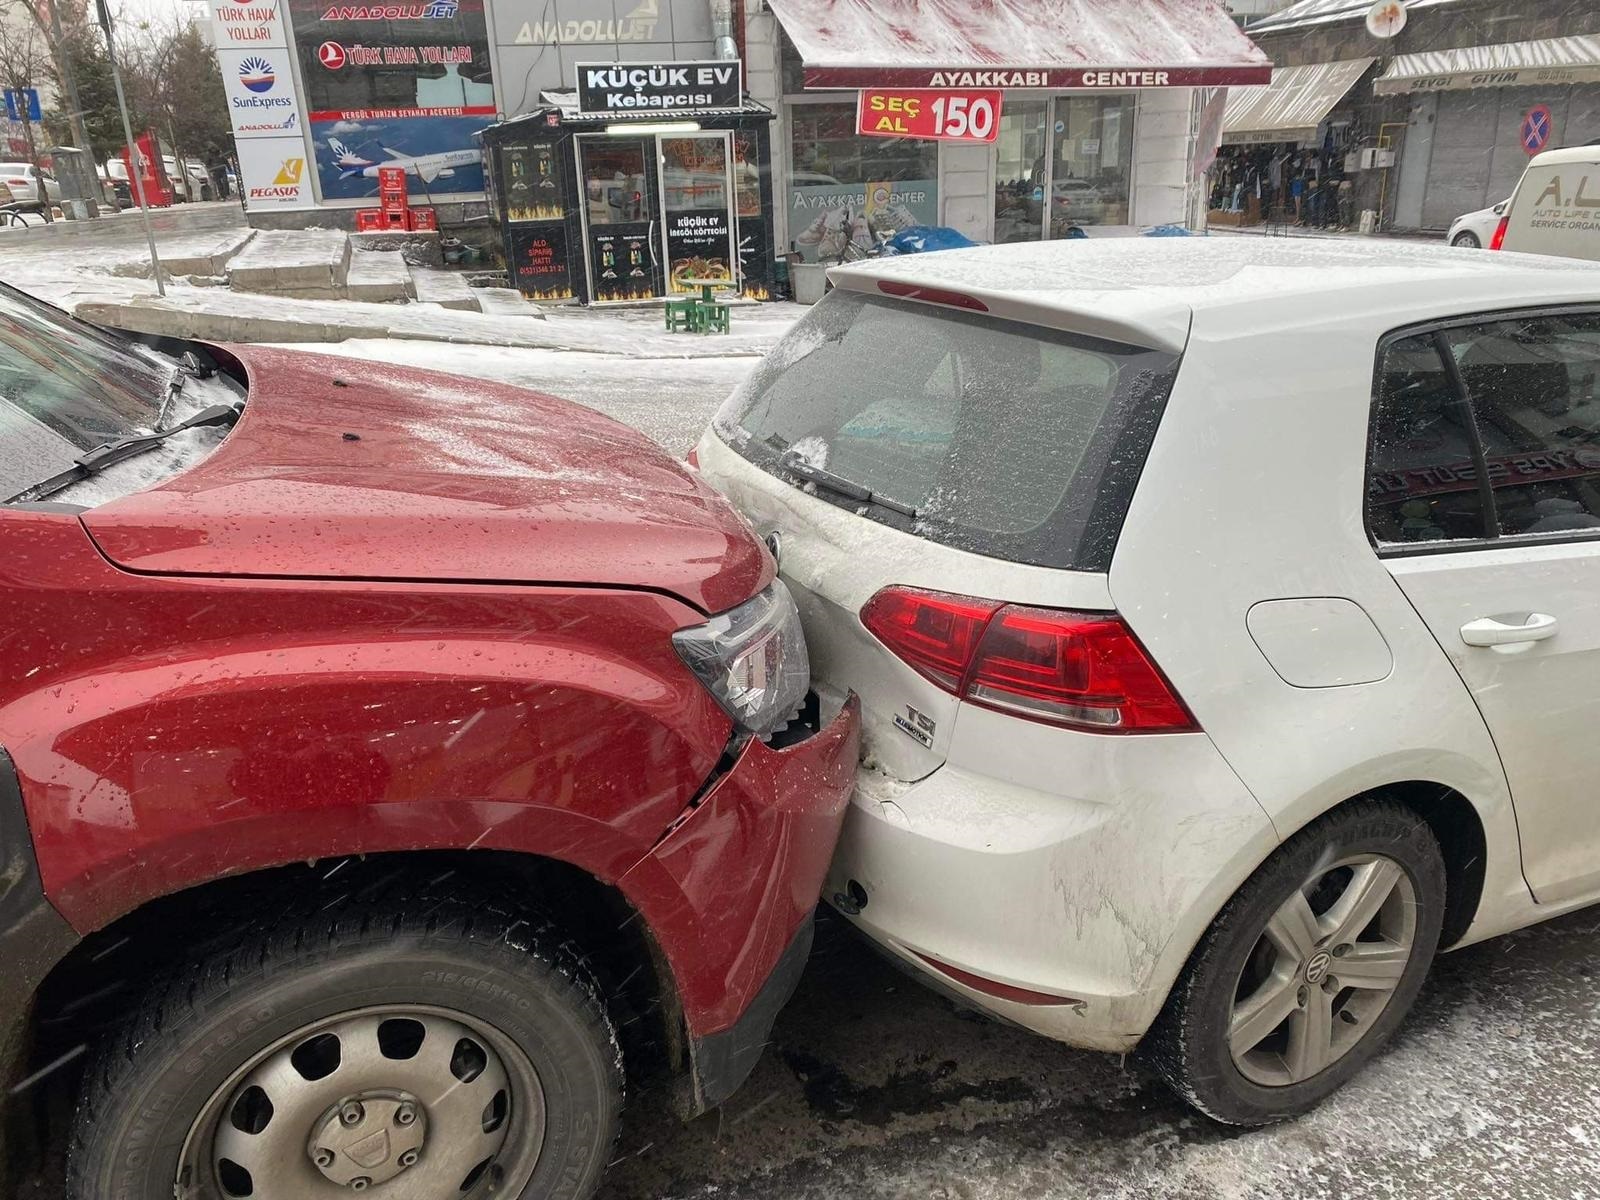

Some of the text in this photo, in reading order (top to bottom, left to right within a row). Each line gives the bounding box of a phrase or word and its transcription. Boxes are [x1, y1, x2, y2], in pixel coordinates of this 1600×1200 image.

[216, 6, 276, 21] TÜRK HAVA
[320, 4, 457, 21] ANADOLUJET
[227, 27, 271, 40] YOLLARI
[515, 19, 658, 43] ANADOLUJET
[346, 45, 473, 65] TÜRK HAVA YOLLARI
[587, 66, 733, 91] KÜÇÜK EV
[929, 71, 1170, 87] AYAKKABI CENTER
[233, 96, 292, 109] SunExpress
[341, 110, 369, 120] VERGÜL
[398, 108, 428, 118] SEYAHAT
[870, 95, 993, 138] SEÇ 150
[238, 121, 295, 131] ANADOLUJET
[875, 117, 909, 132] AL
[250, 187, 299, 197] PEGASUS
[793, 187, 925, 209] AYAKKABI CENTER
[677, 216, 719, 227] KÜÇÜK EV
[1533, 209, 1561, 218] AUTO
[1565, 210, 1590, 219] LIFE
[1530, 220, 1568, 229] SERVICE
